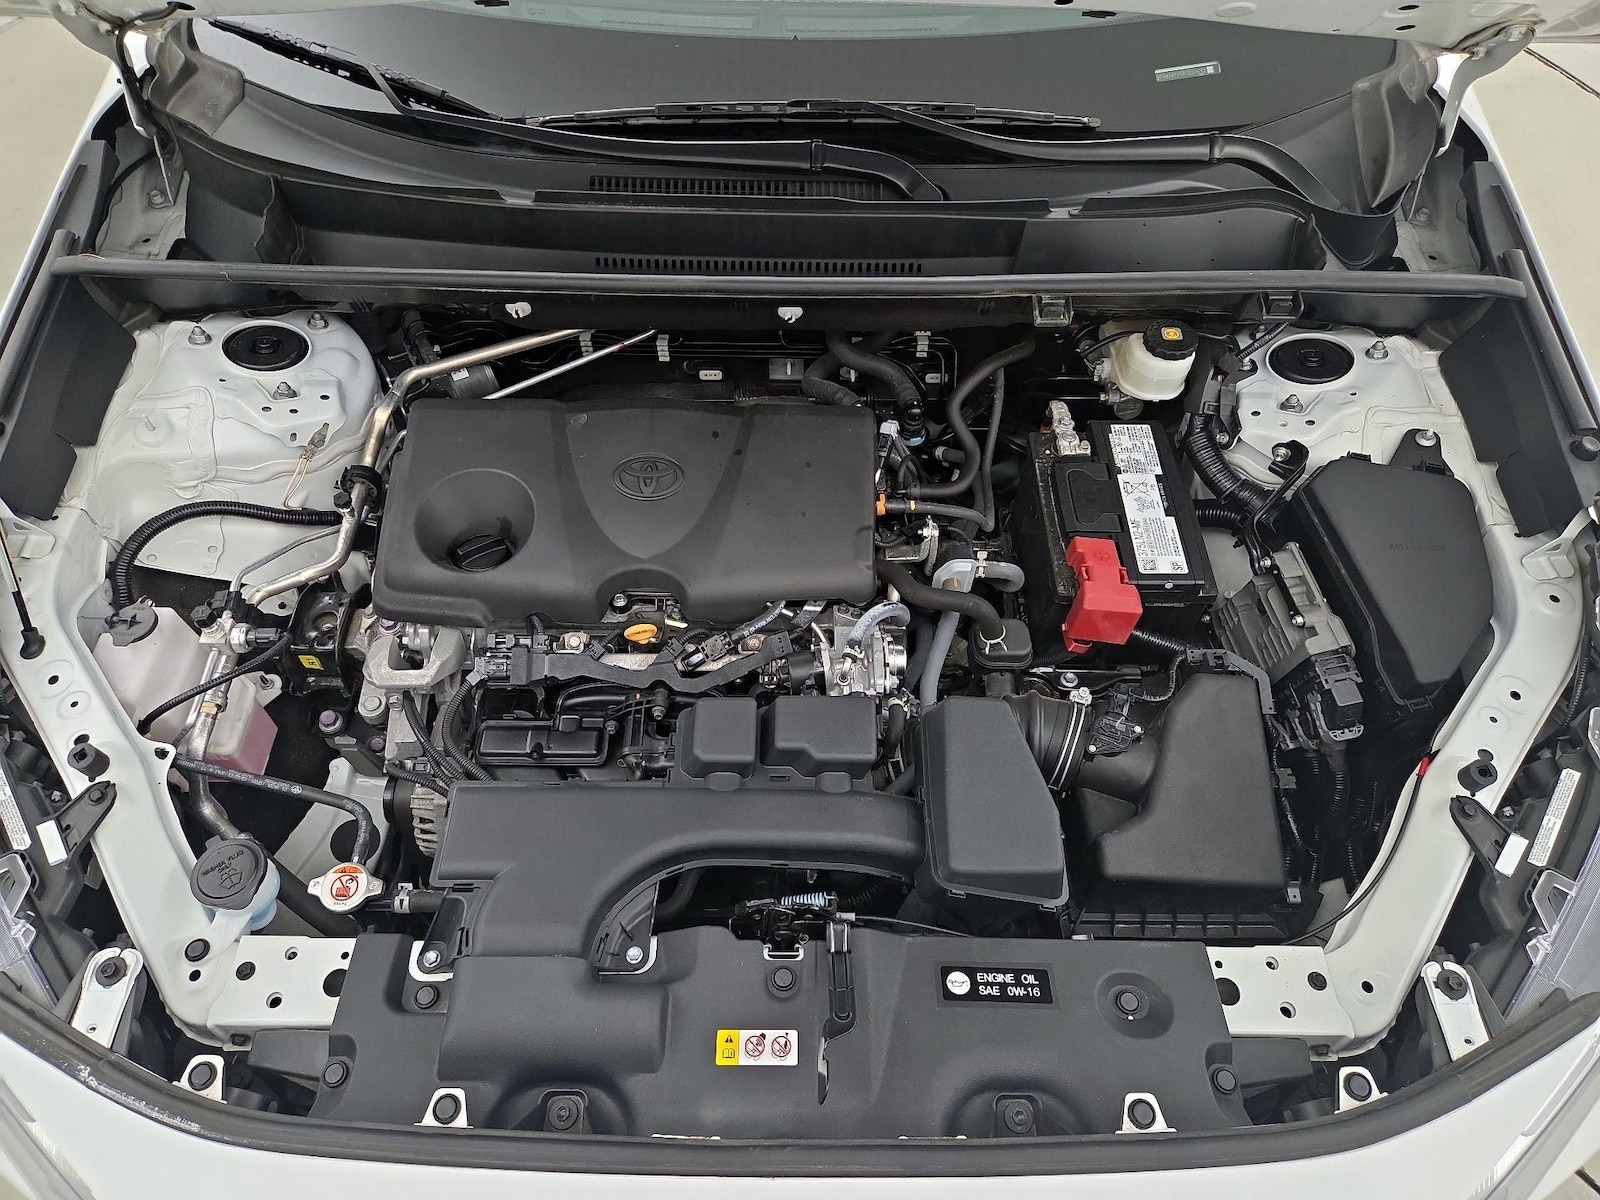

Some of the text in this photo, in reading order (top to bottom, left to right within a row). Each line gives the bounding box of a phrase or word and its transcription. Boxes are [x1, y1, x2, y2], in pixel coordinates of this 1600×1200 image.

[1171, 562, 1184, 571] SP
[202, 850, 244, 877] WASHER FLUID
[217, 862, 232, 873] ONLY
[976, 972, 1040, 985] ENGINE OIL
[978, 985, 1041, 998] SAE 0W-16
